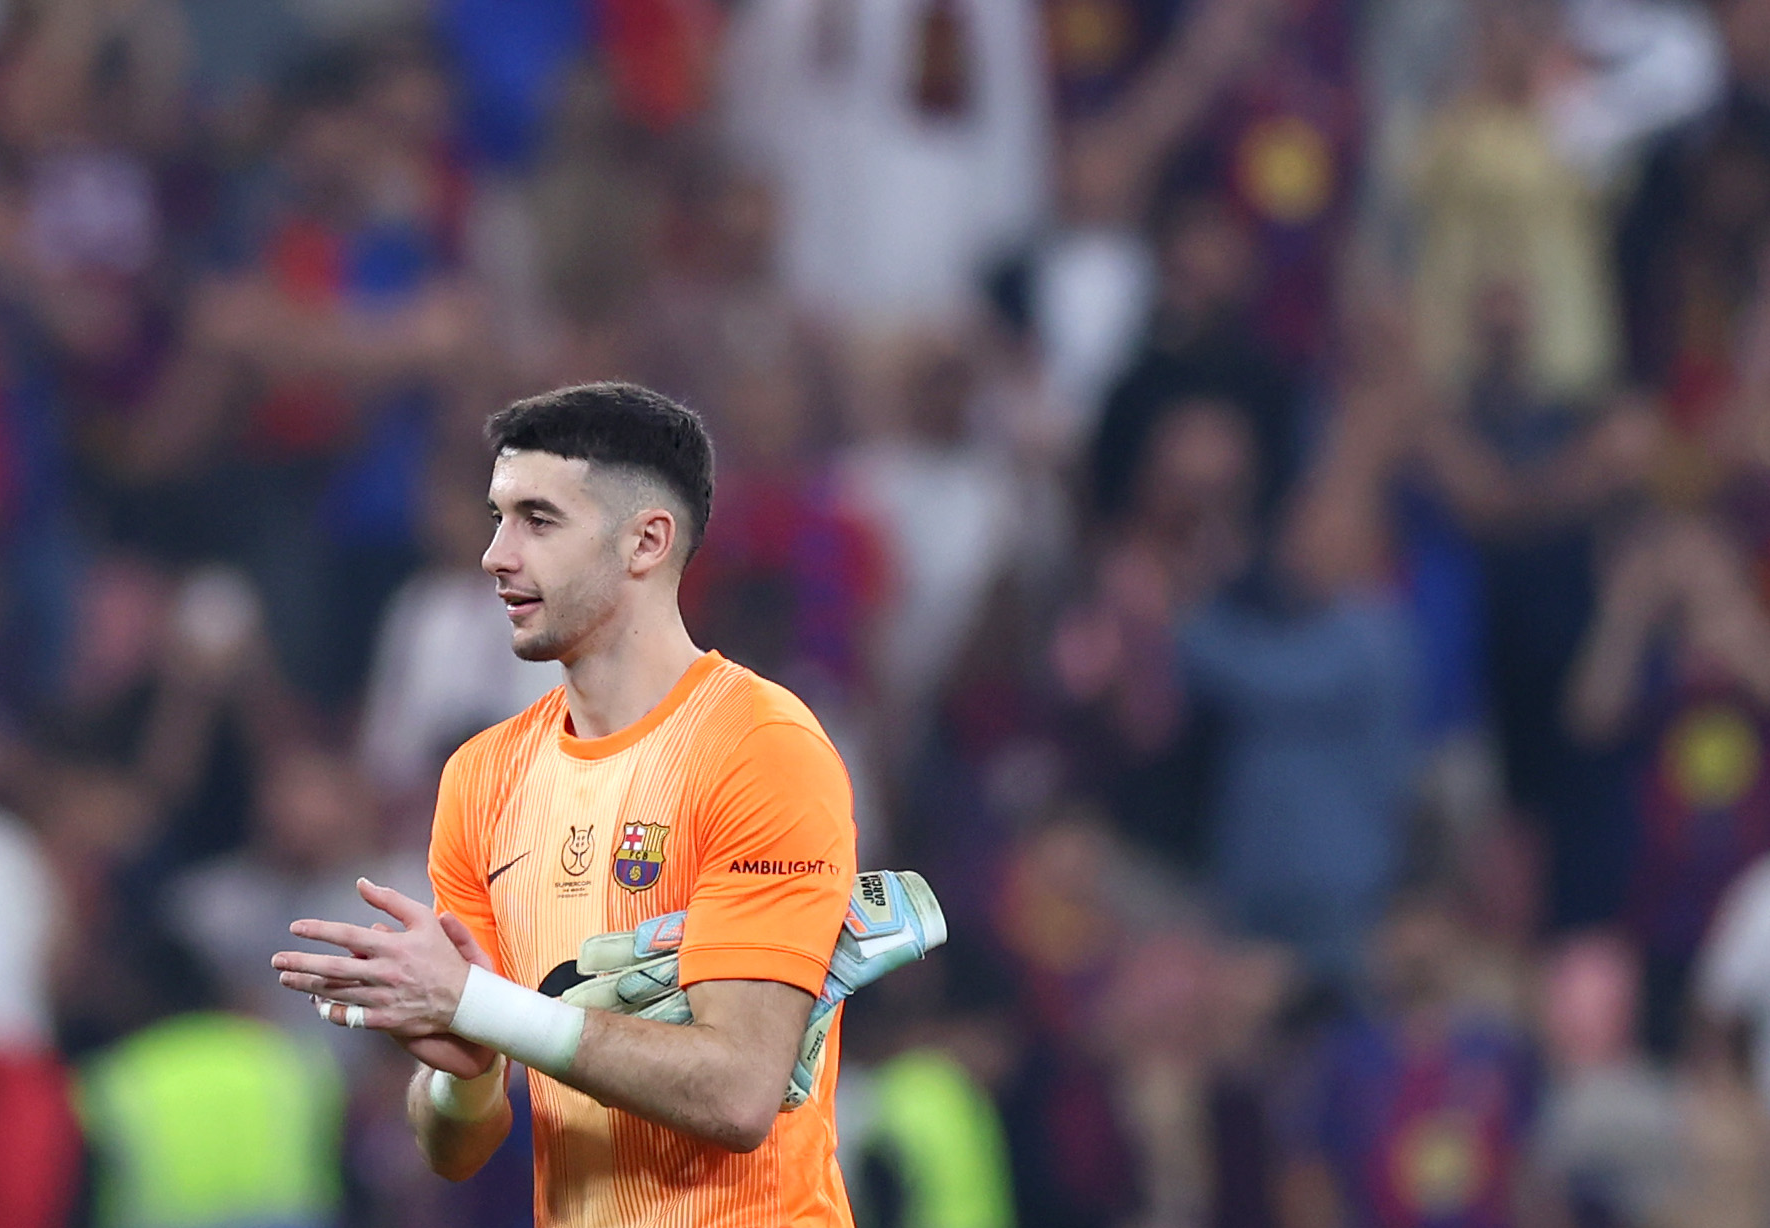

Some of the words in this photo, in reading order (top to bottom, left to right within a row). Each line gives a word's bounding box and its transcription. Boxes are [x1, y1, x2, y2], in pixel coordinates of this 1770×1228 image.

[629, 850, 649, 861] FCB
[728, 860, 825, 875] AMBILIGHT
[859, 875, 875, 904] JOAN
